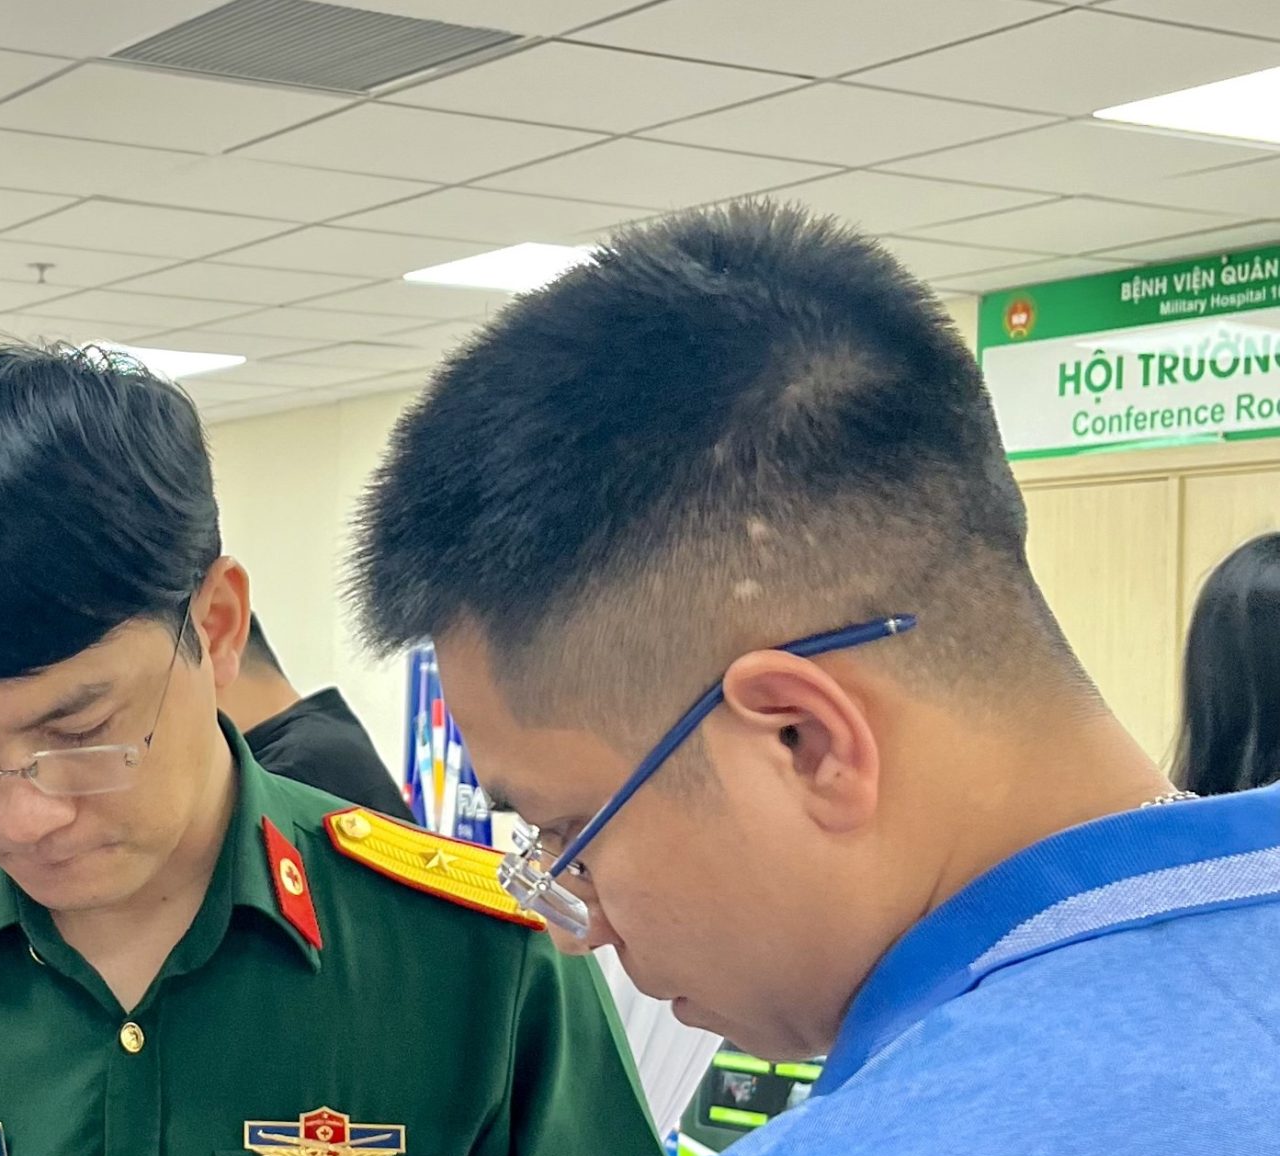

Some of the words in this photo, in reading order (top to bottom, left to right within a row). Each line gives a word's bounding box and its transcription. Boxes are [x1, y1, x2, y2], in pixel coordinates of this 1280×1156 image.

[1121, 275, 1168, 304] BỆNH
[1173, 266, 1215, 295] VIỆN
[1159, 298, 1207, 315] Military
[1211, 286, 1266, 308] Hospital
[1058, 348, 1124, 404] HỘI
[1137, 332, 1280, 387] TRƯỜN
[1072, 403, 1225, 437] Conference
[1236, 393, 1280, 421] Ro
